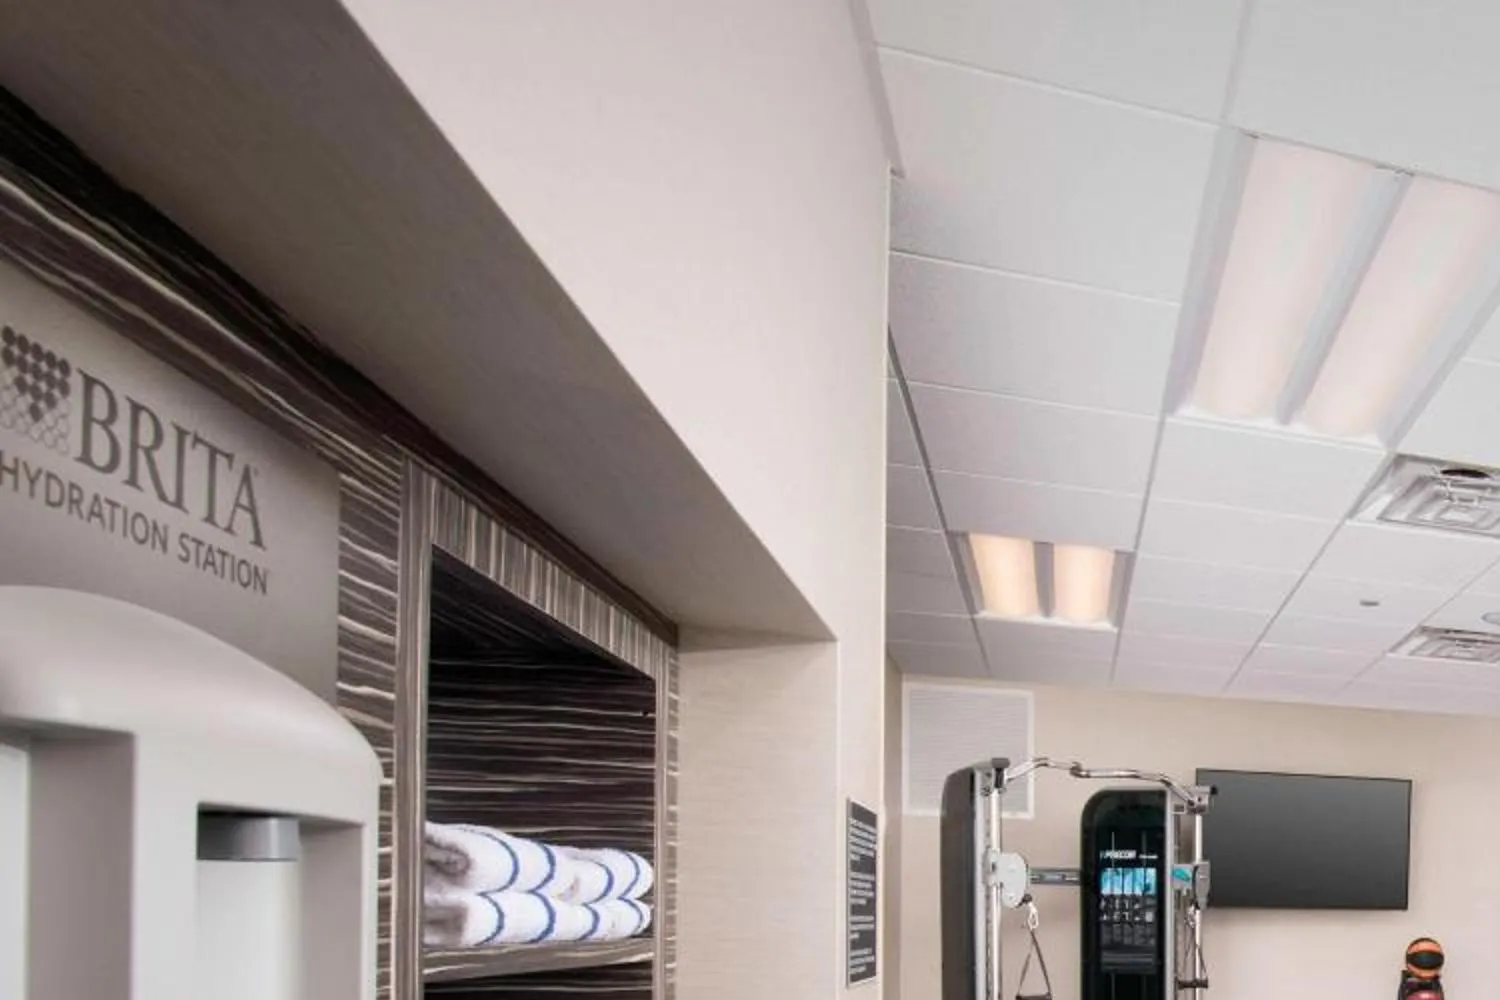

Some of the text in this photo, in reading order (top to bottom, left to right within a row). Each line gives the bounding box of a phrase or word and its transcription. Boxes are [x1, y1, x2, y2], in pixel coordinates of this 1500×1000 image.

[0, 451, 269, 596] HYDRATION STATION
[73, 367, 268, 551] BRITA
